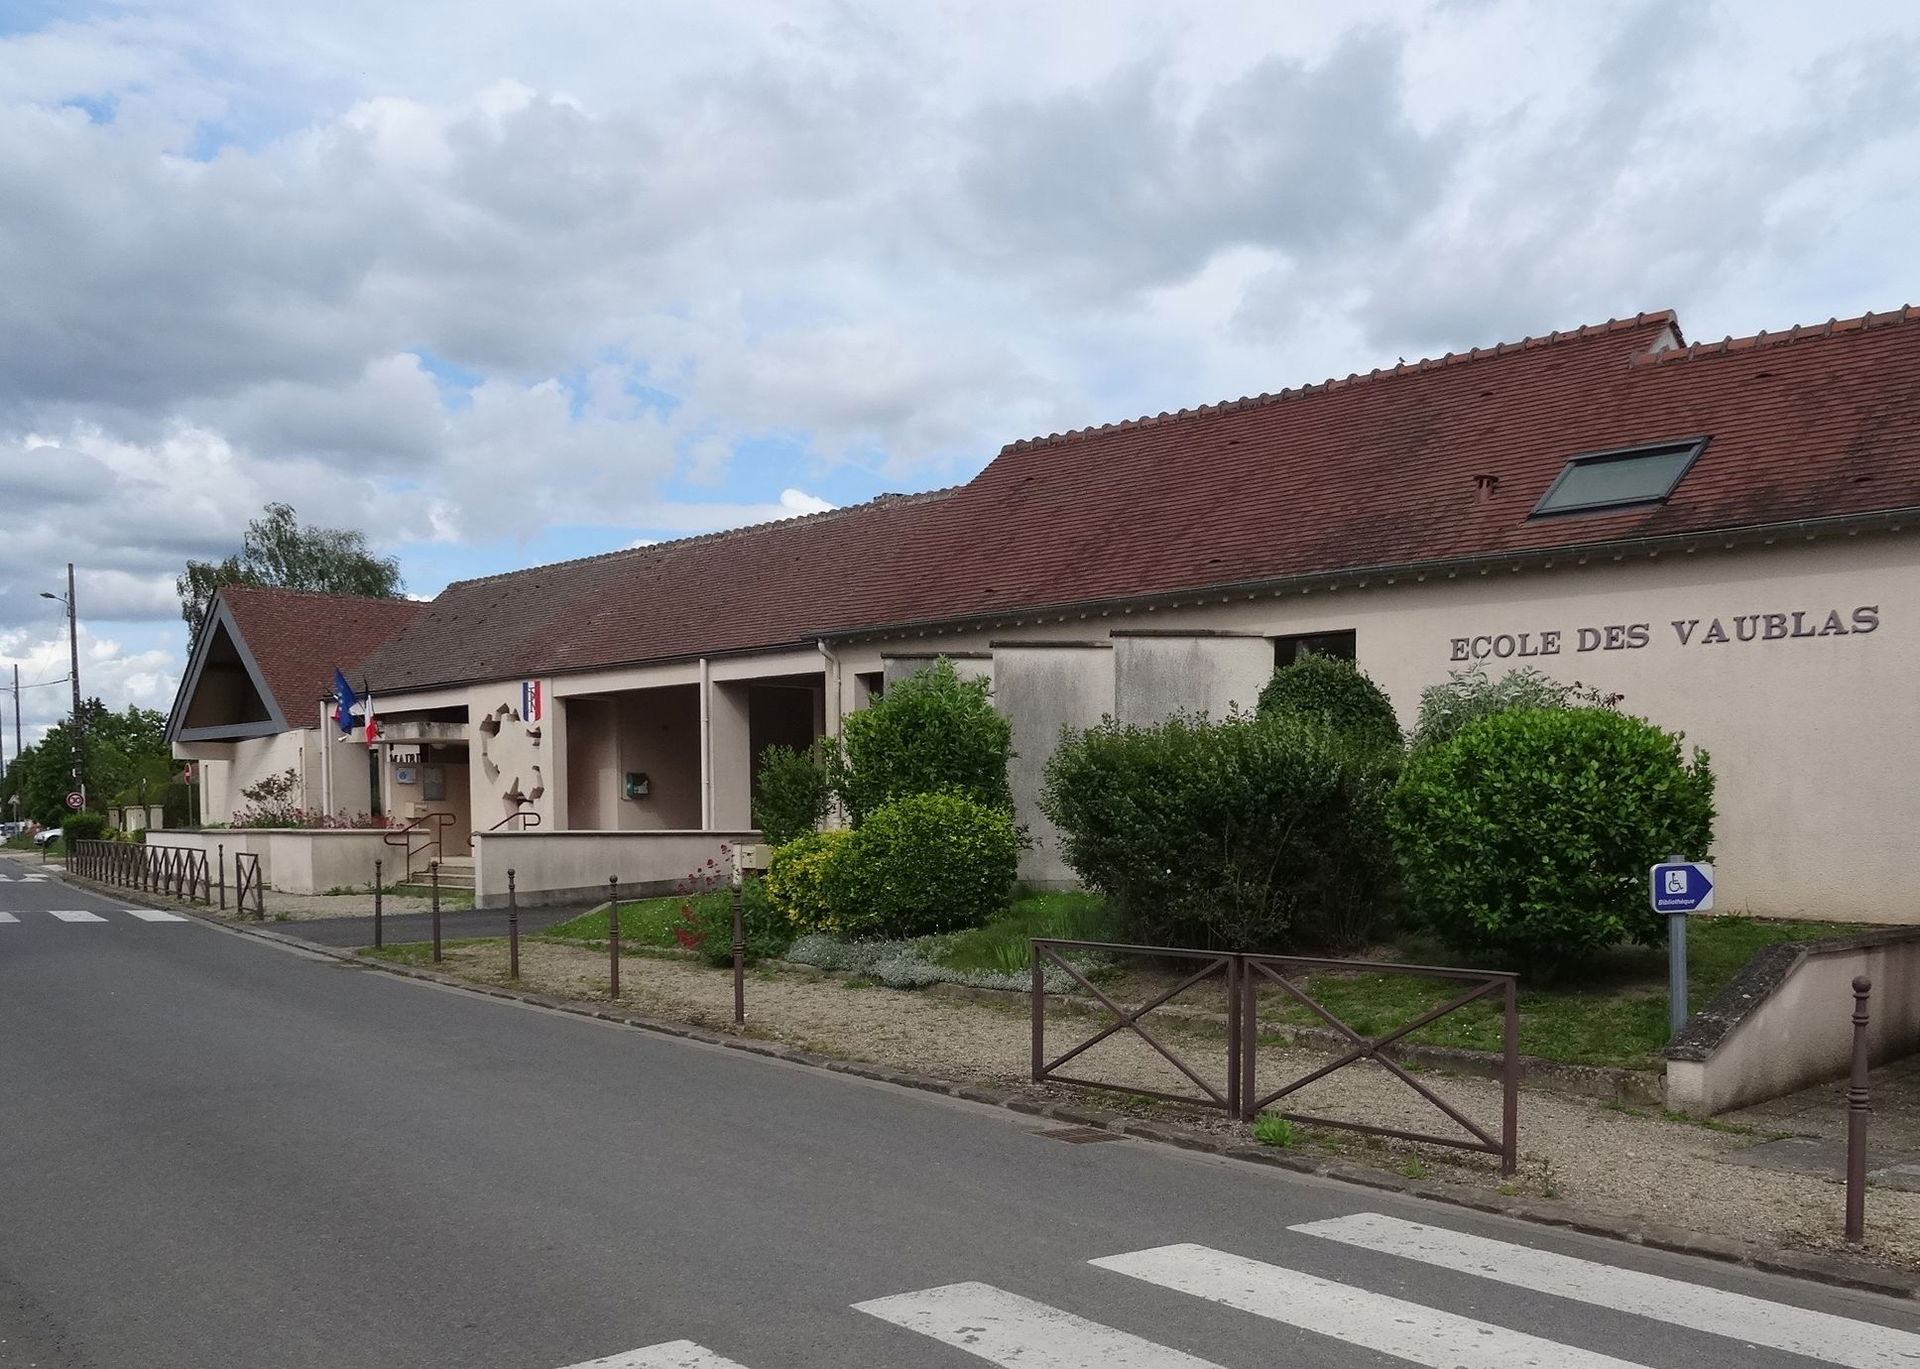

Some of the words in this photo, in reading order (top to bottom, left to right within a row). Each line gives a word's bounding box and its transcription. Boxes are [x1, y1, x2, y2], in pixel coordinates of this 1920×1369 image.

[1450, 631, 1562, 661] ECOLE
[1576, 623, 1651, 652] DES
[1671, 605, 1880, 646] VAUBLAS
[71, 796, 81, 804] 30
